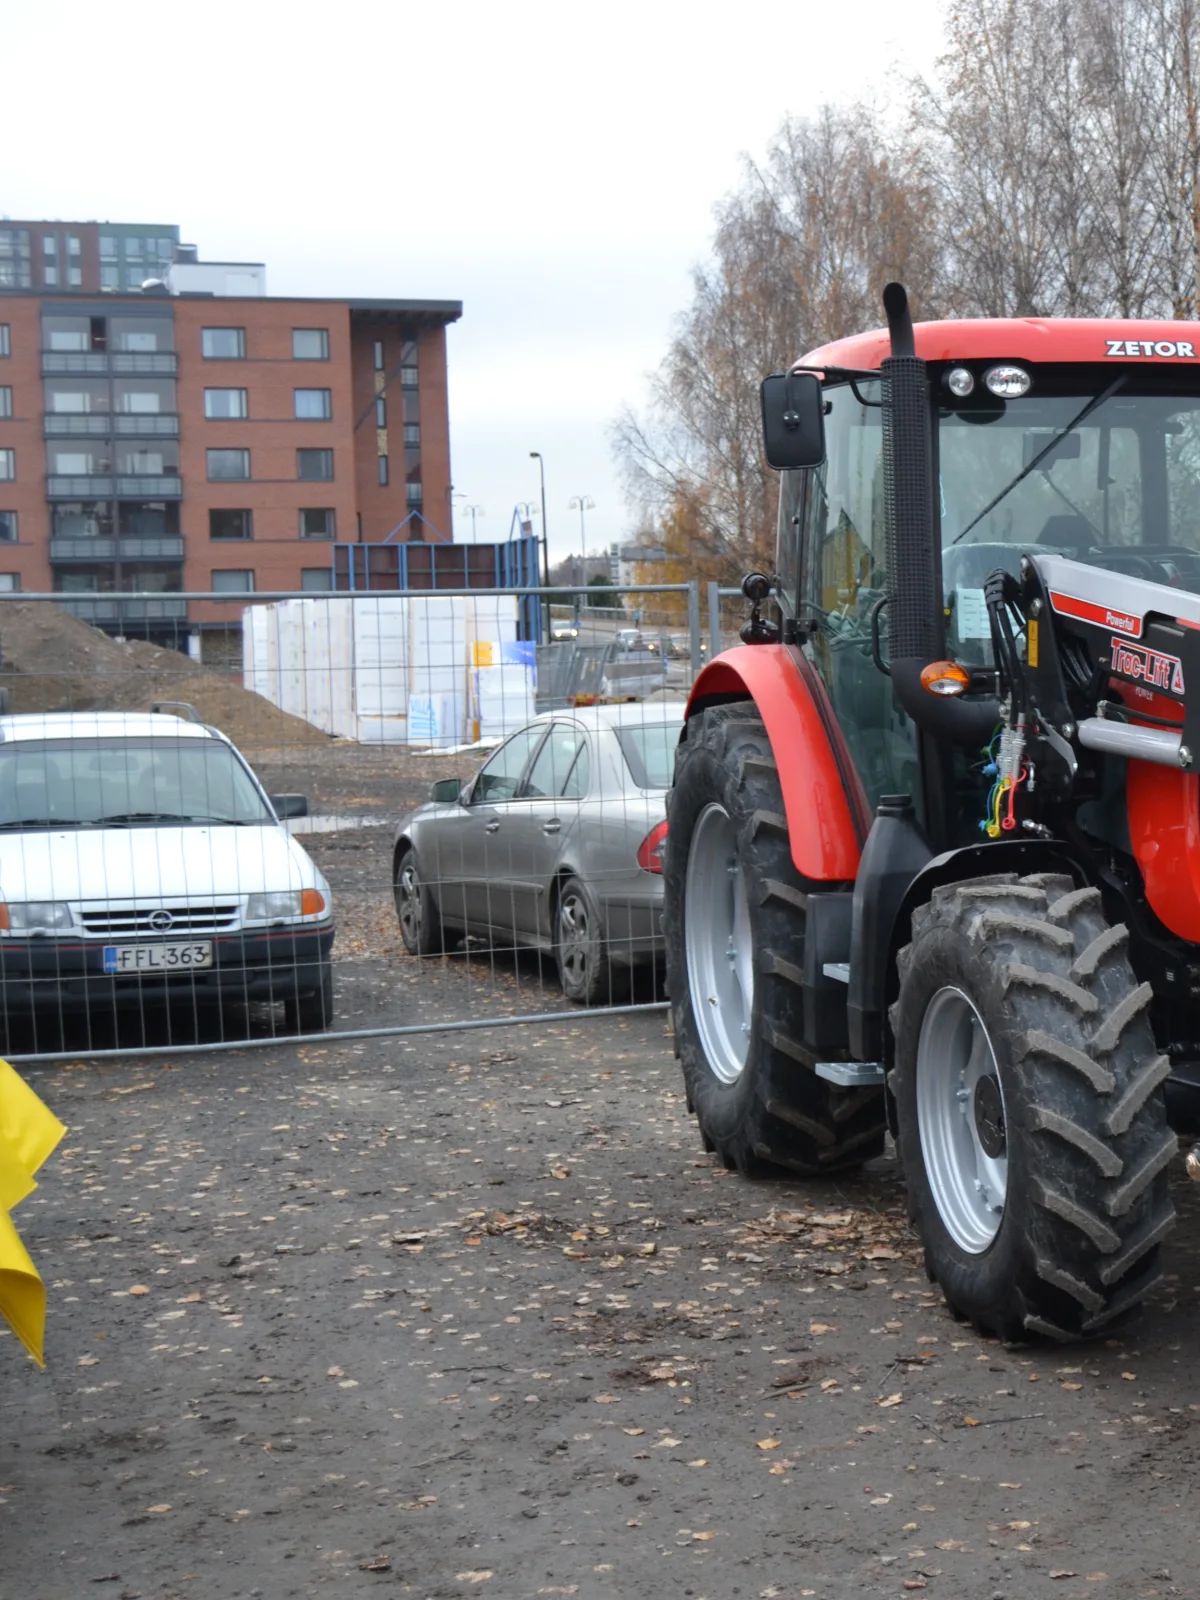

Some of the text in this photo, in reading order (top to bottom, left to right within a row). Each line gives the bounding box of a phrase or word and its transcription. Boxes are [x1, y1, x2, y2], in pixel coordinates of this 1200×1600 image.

[1104, 340, 1198, 358] ZETOR
[1106, 611, 1135, 631] Powerful
[1111, 636, 1181, 690] Trac-Lift
[121, 946, 206, 968] FFL-363
